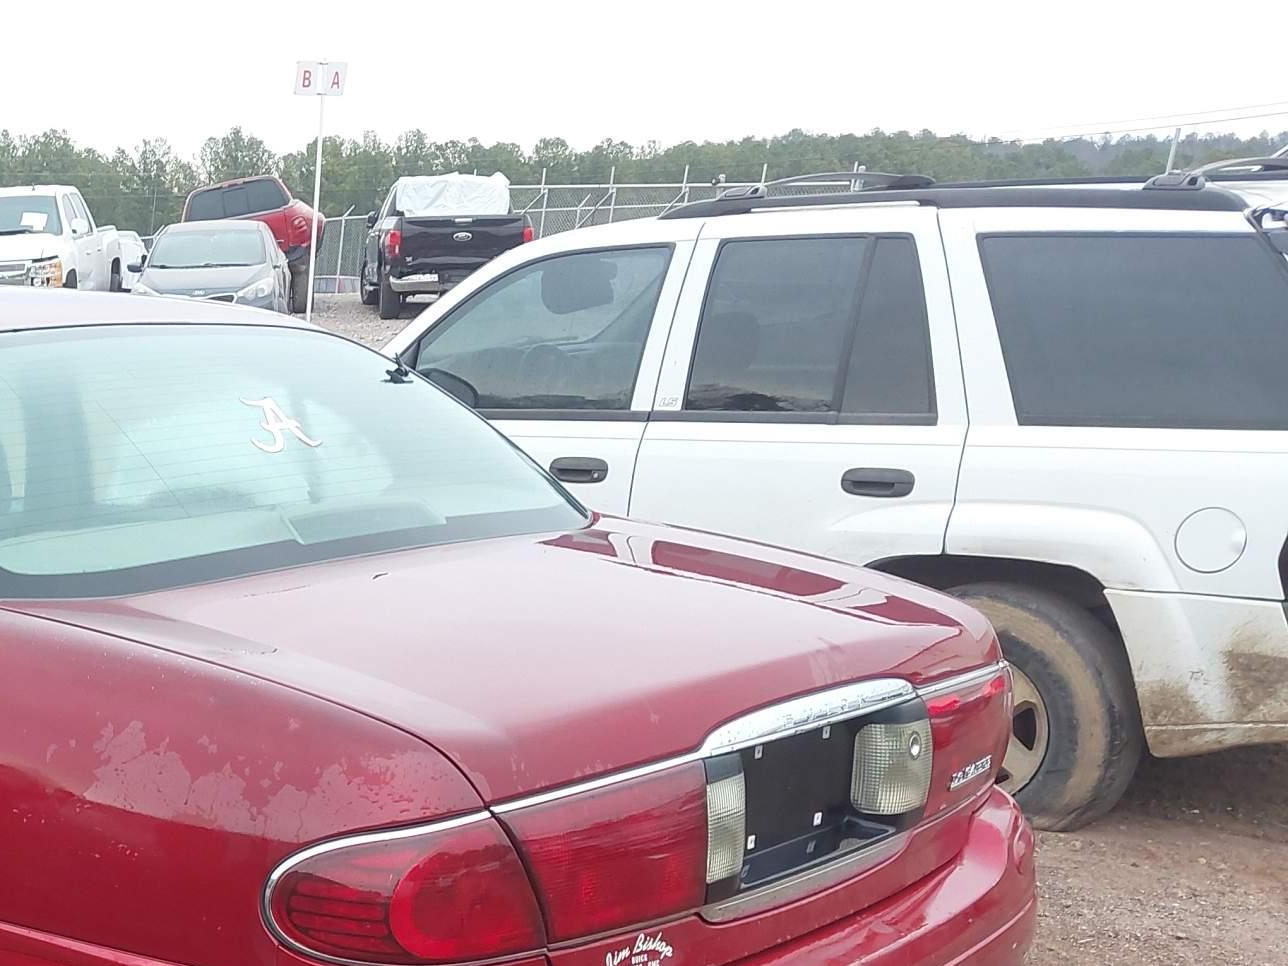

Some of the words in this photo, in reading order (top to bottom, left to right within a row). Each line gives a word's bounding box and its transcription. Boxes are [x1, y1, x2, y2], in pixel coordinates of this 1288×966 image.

[302, 70, 312, 88] B
[330, 71, 340, 89] A
[632, 931, 673, 960] Bishop
